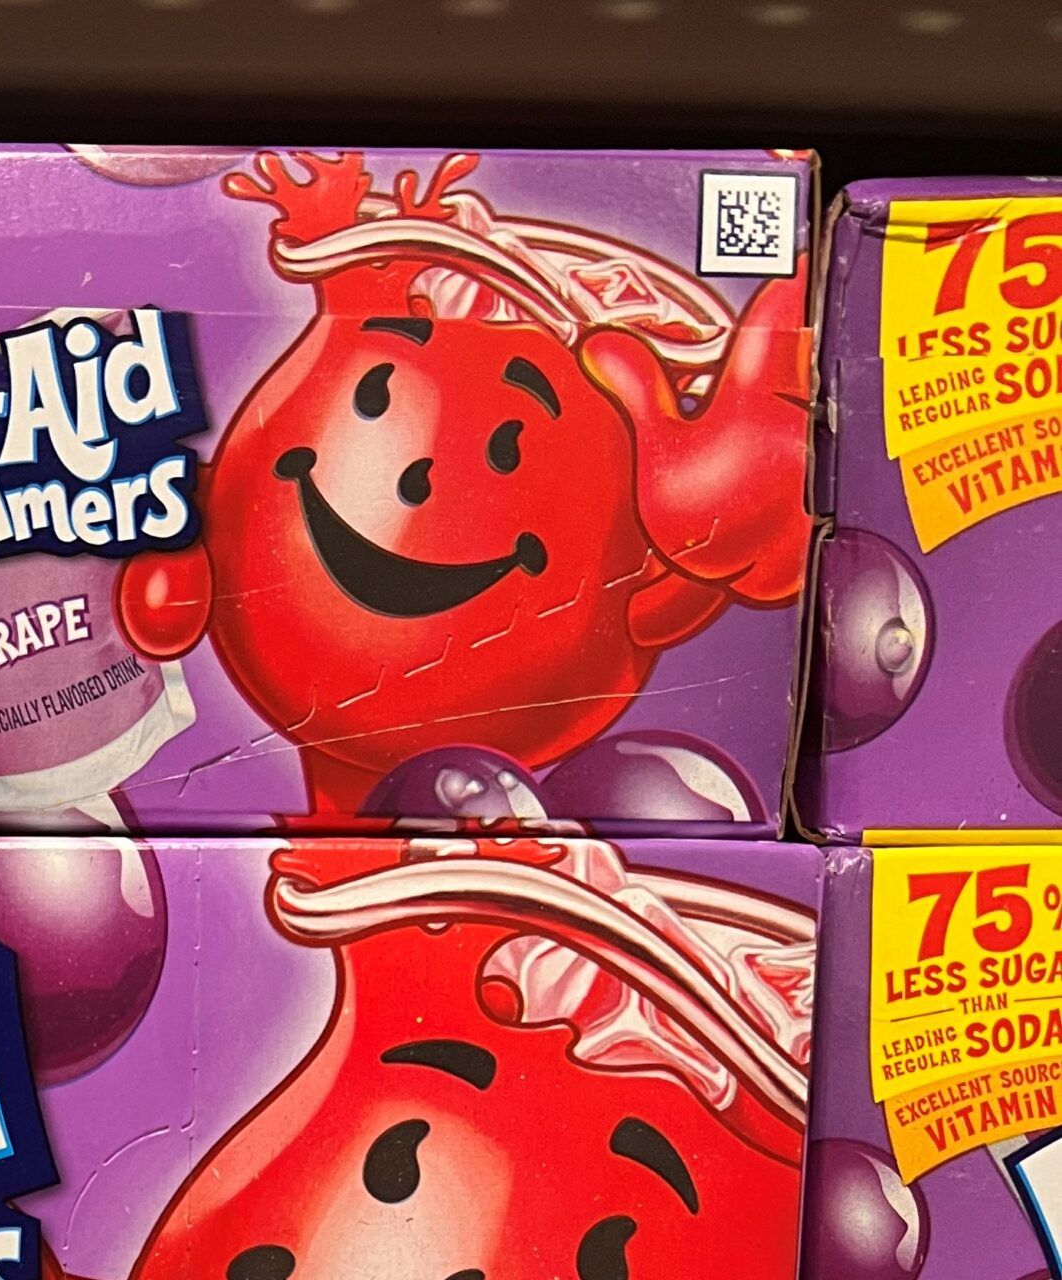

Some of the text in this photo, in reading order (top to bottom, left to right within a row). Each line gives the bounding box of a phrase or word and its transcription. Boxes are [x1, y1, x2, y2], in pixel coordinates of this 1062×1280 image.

[899, 392, 991, 432] REGULAR
[912, 424, 1024, 486] EXCELLENT
[44, 674, 106, 719] FLAVORED
[108, 654, 144, 691] DRINK
[886, 961, 967, 1003] LESS
[958, 993, 1008, 1015] THAN
[883, 1048, 962, 1081] REGULAR
[895, 1075, 993, 1128] EXCELLENT
